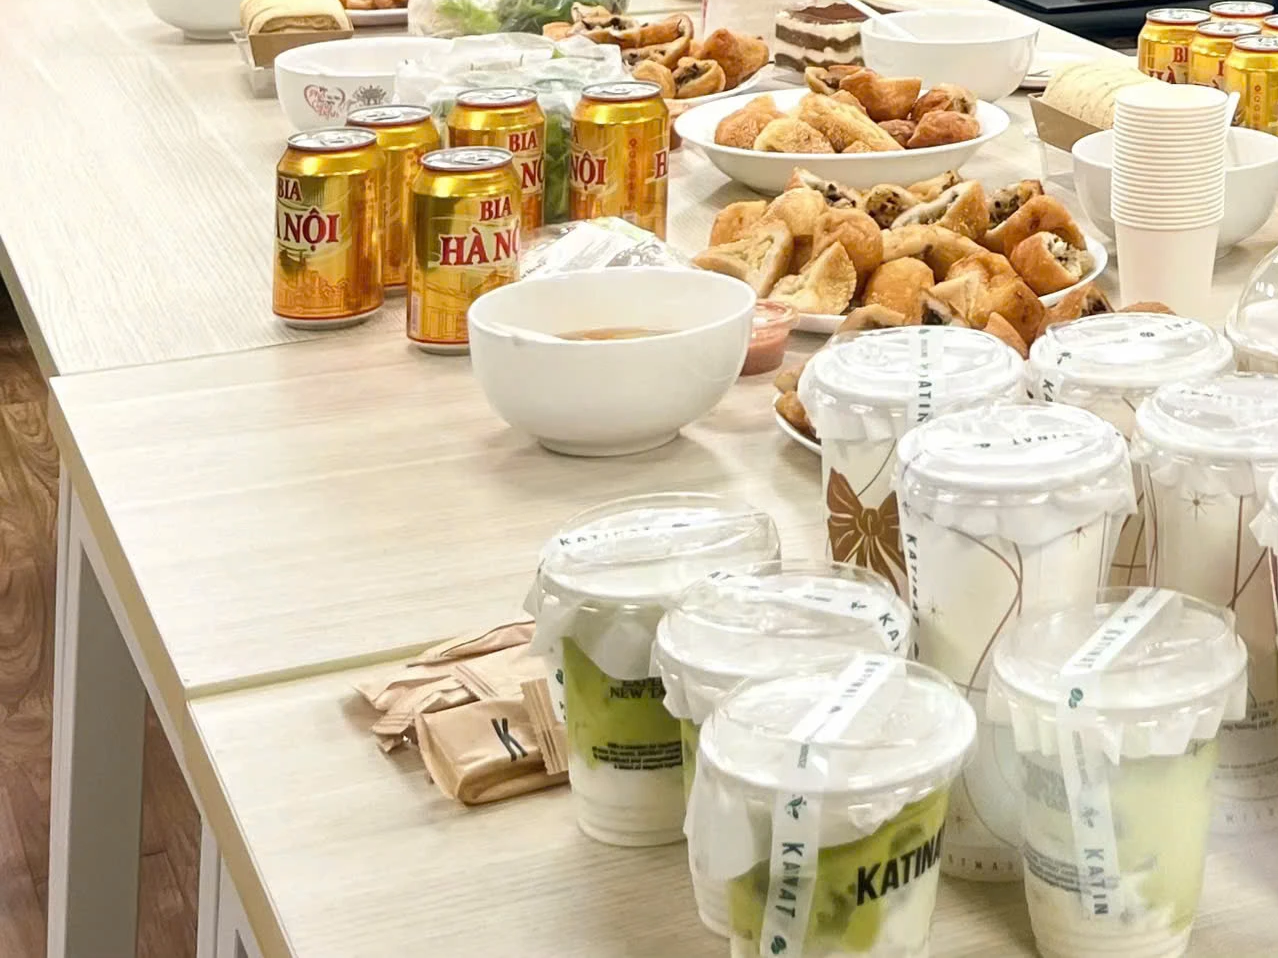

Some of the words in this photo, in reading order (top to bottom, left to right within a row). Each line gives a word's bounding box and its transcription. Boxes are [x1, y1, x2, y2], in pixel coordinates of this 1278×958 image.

[1173, 46, 1188, 63] BI
[509, 130, 537, 153] BIA
[480, 196, 512, 221] BIA
[284, 207, 340, 252] NỘI
[440, 226, 489, 266] HÀ
[1084, 848, 1109, 916] KATIN
